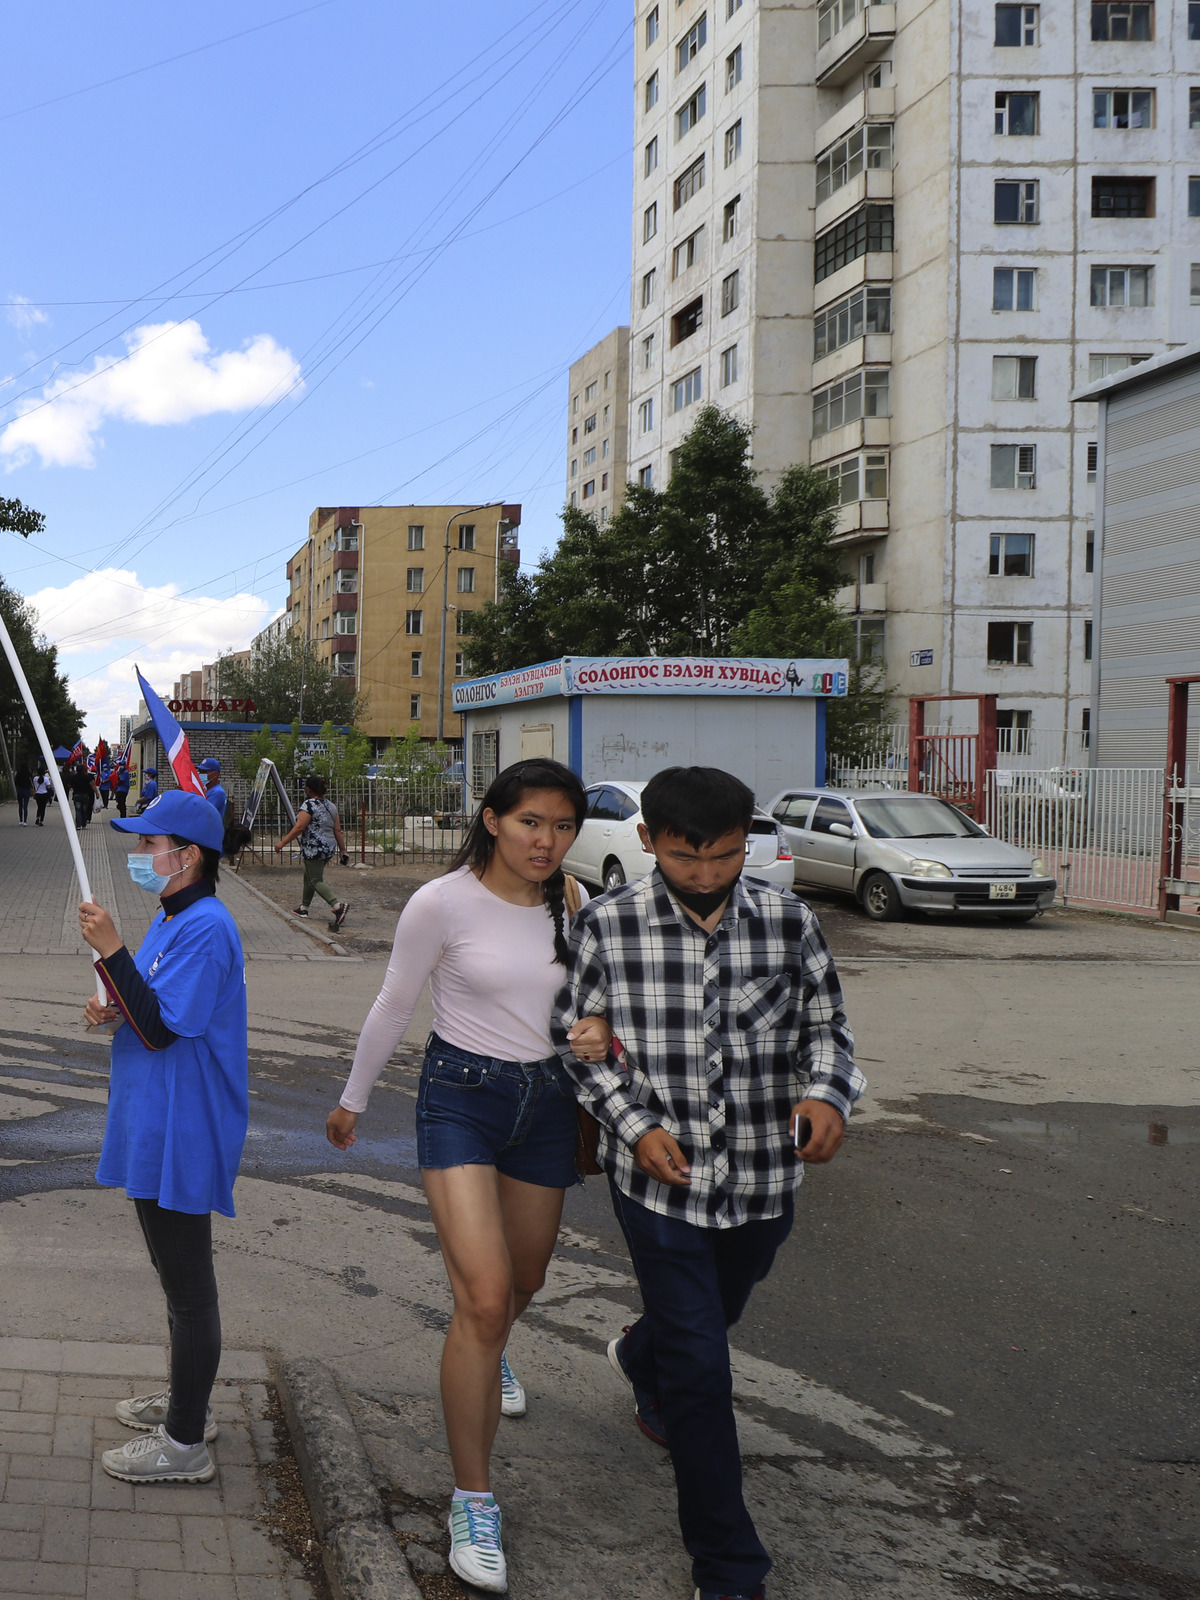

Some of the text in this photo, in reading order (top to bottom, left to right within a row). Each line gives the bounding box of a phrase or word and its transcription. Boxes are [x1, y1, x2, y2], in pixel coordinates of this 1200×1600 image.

[911, 653, 919, 665] 17
[500, 675, 521, 688] БЭЛЭН
[578, 664, 782, 685] СОЛОНГОС БЭЛЭН ХУВЦАС
[812, 674, 846, 690] ALE
[455, 681, 497, 704] СОЛОНГОС
[513, 682, 544, 699] ДЭЛГҮҮР
[168, 699, 258, 712] ОМБАРД
